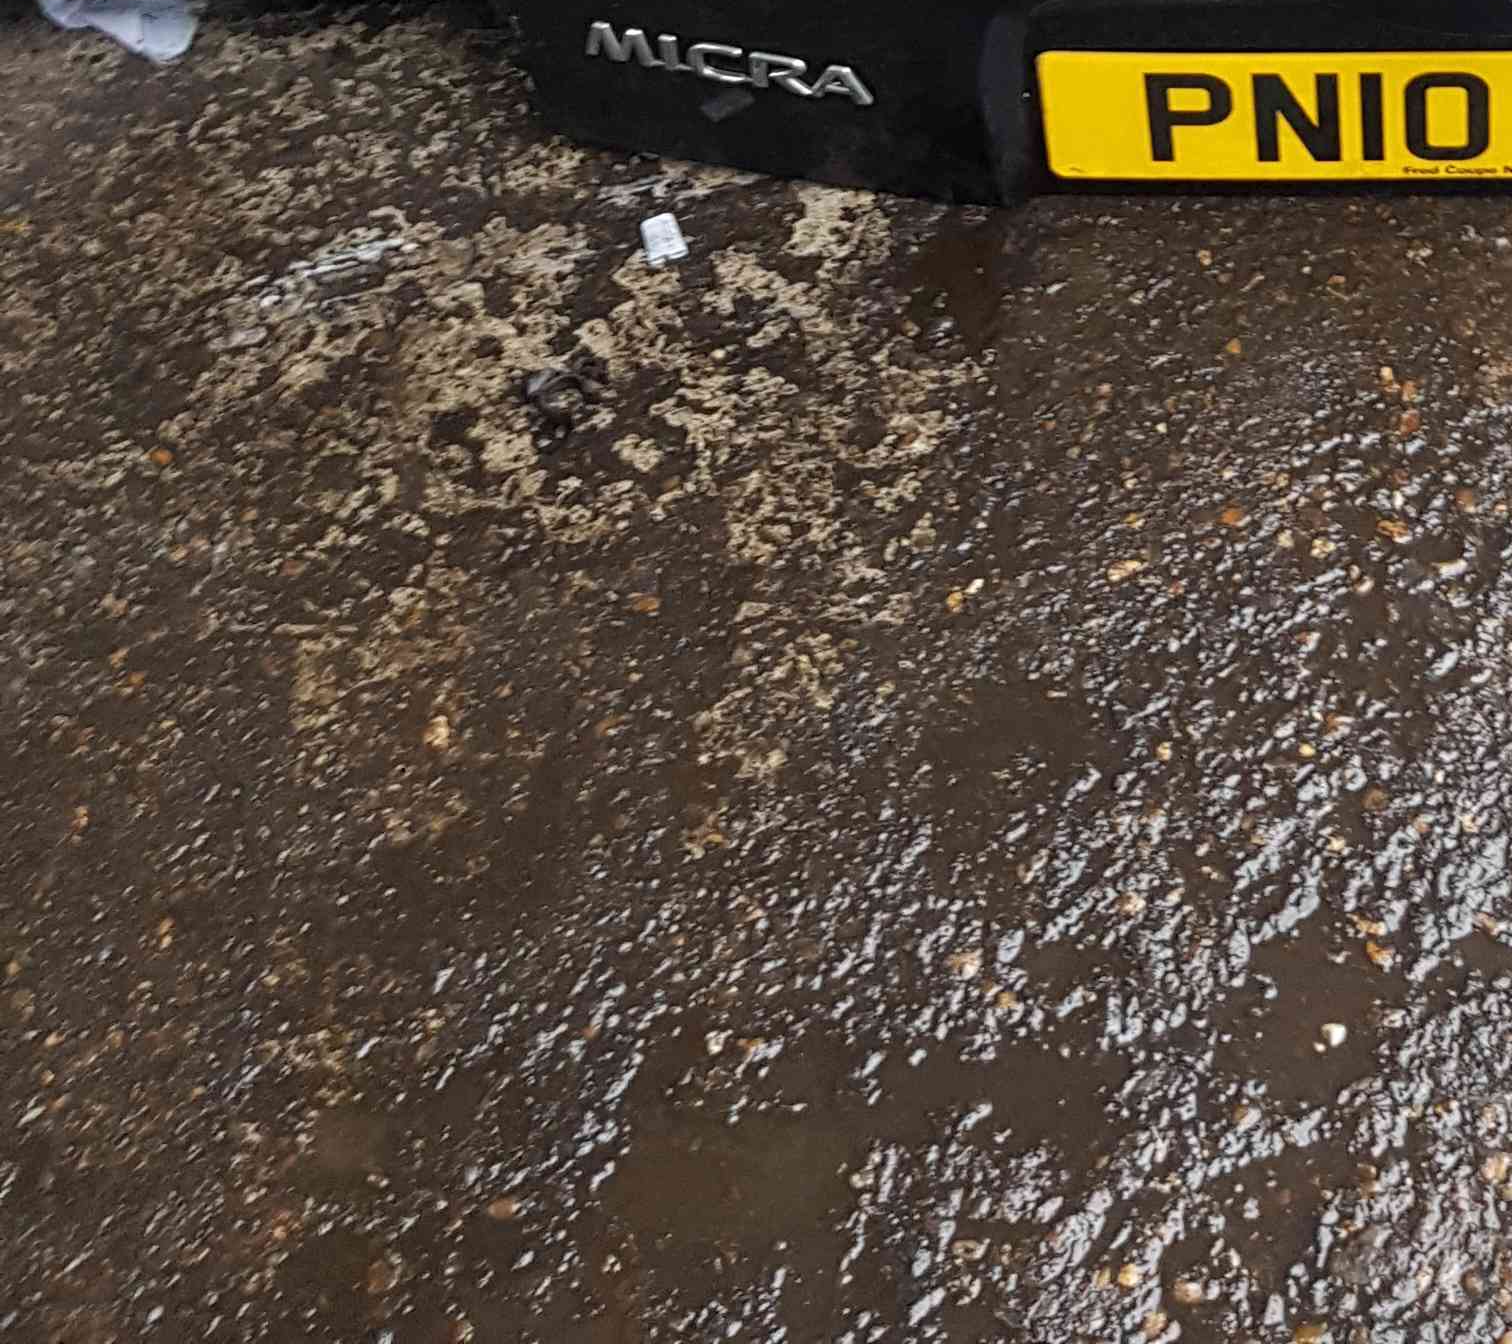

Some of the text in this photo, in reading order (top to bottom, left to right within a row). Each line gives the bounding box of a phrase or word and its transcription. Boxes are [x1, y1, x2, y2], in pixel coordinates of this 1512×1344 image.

[585, 21, 874, 105] MICRA
[1144, 70, 1491, 162] PN10
[1403, 166, 1440, 175] Fred
[1445, 165, 1497, 175] Coupe
